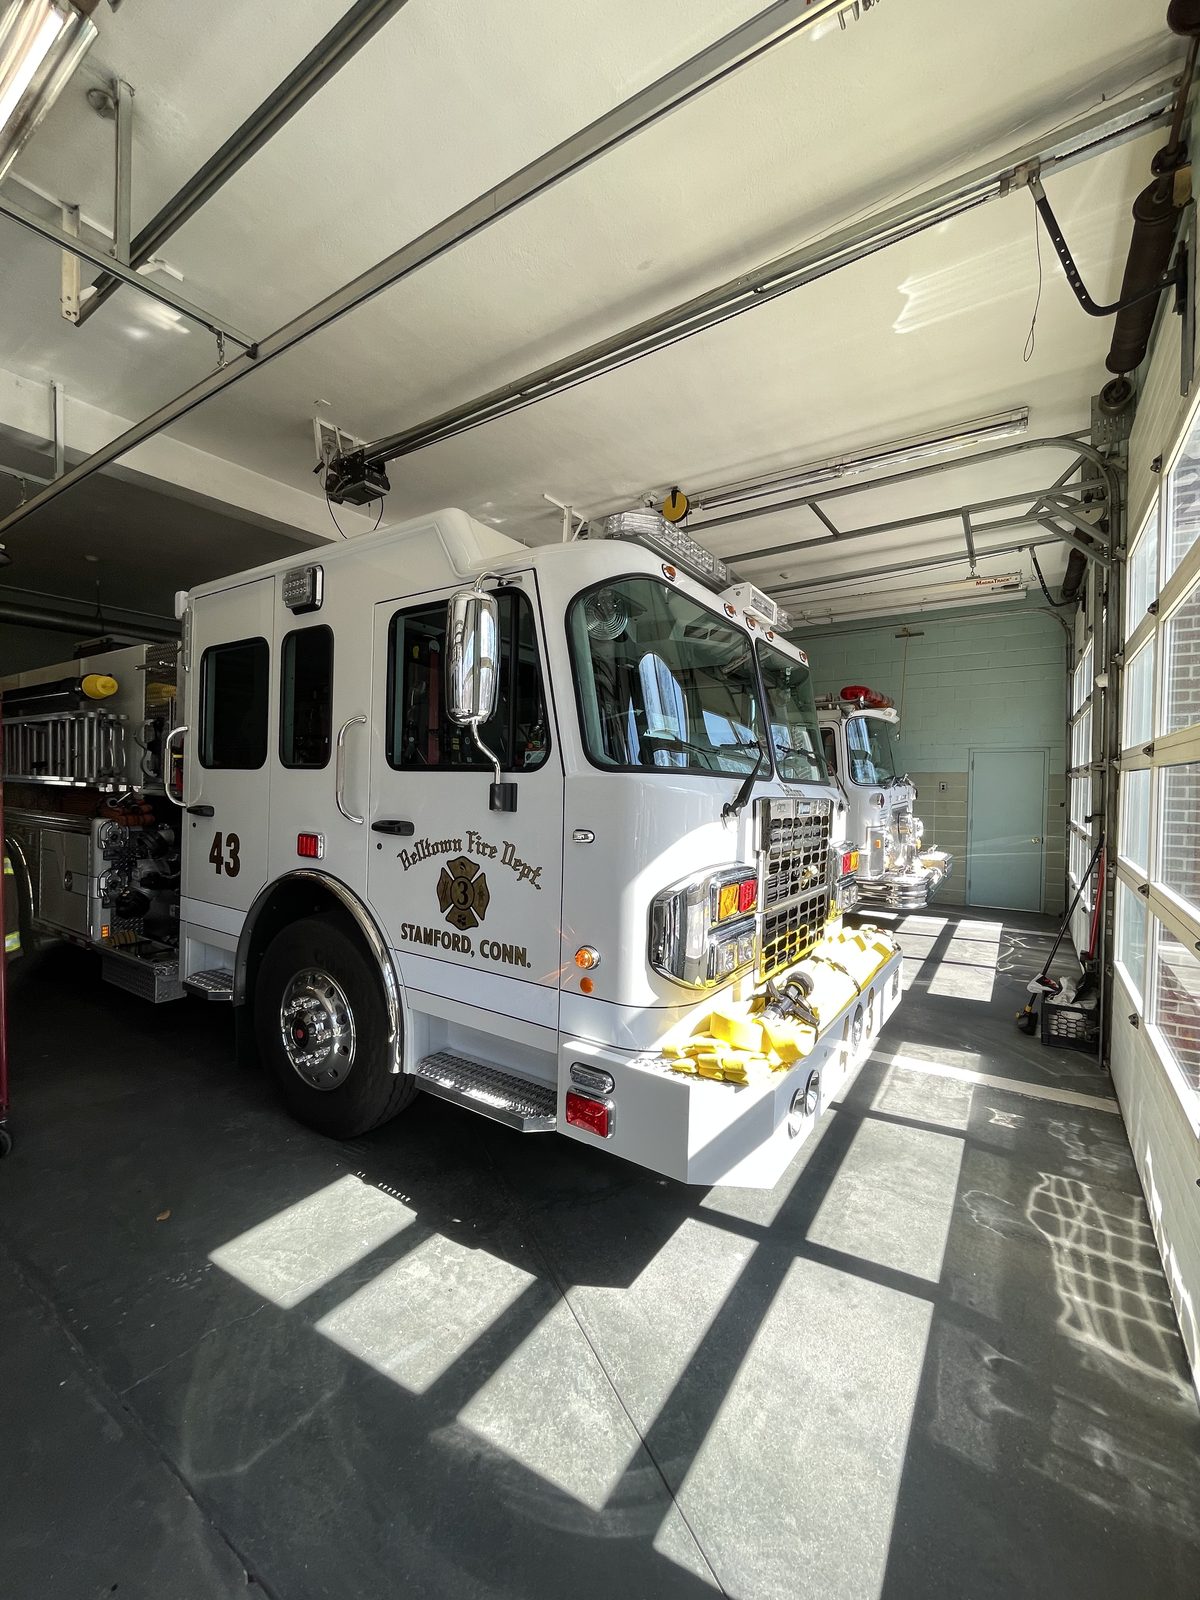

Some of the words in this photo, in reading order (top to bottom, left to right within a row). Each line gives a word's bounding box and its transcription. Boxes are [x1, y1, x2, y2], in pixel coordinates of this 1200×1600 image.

[209, 831, 241, 878] 43
[397, 837, 462, 871] Belltown
[466, 830, 498, 859] Fire
[500, 840, 542, 890] Dept.
[457, 881, 469, 906] 3
[400, 923, 475, 957] STAMFORD,
[479, 940, 532, 968] CONN.
